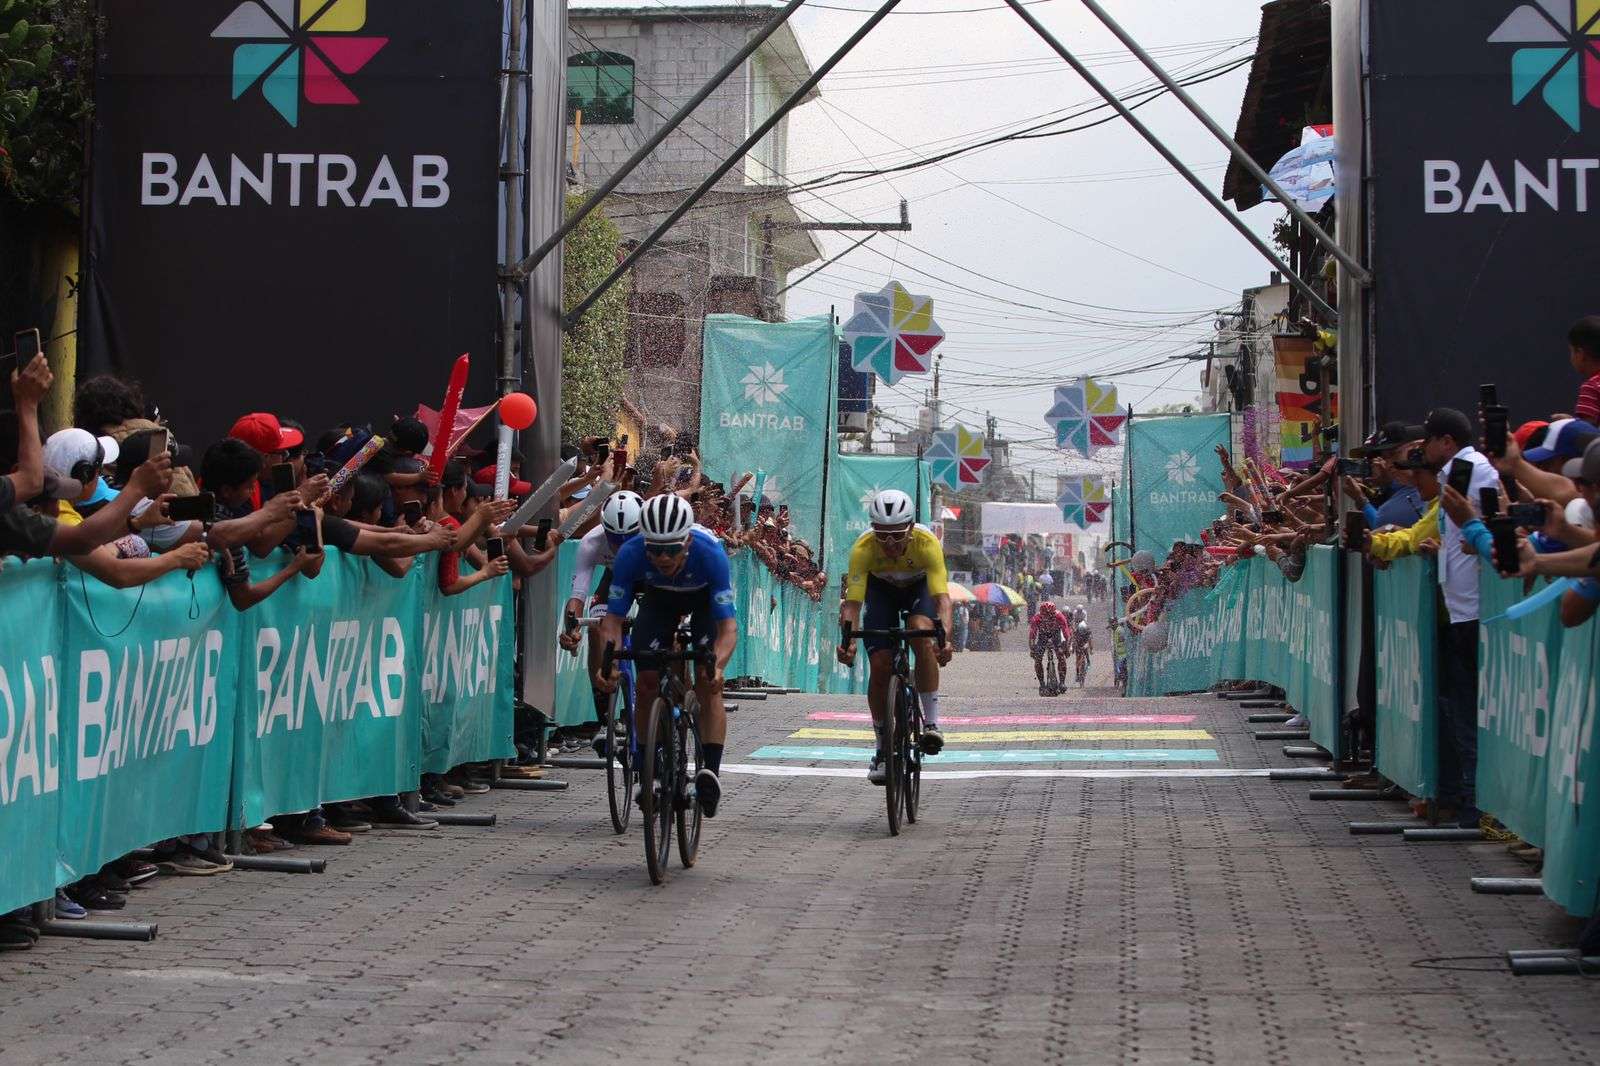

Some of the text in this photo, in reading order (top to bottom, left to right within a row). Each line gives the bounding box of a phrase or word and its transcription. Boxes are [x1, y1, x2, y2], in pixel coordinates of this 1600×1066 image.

[141, 152, 450, 208] BANTRAB
[1423, 158, 1600, 214] BANT
[719, 411, 805, 432] BANTRAB
[1150, 489, 1217, 504] BANTRAB
[77, 630, 223, 781] BANTRAB
[256, 617, 406, 738] BANTRAB
